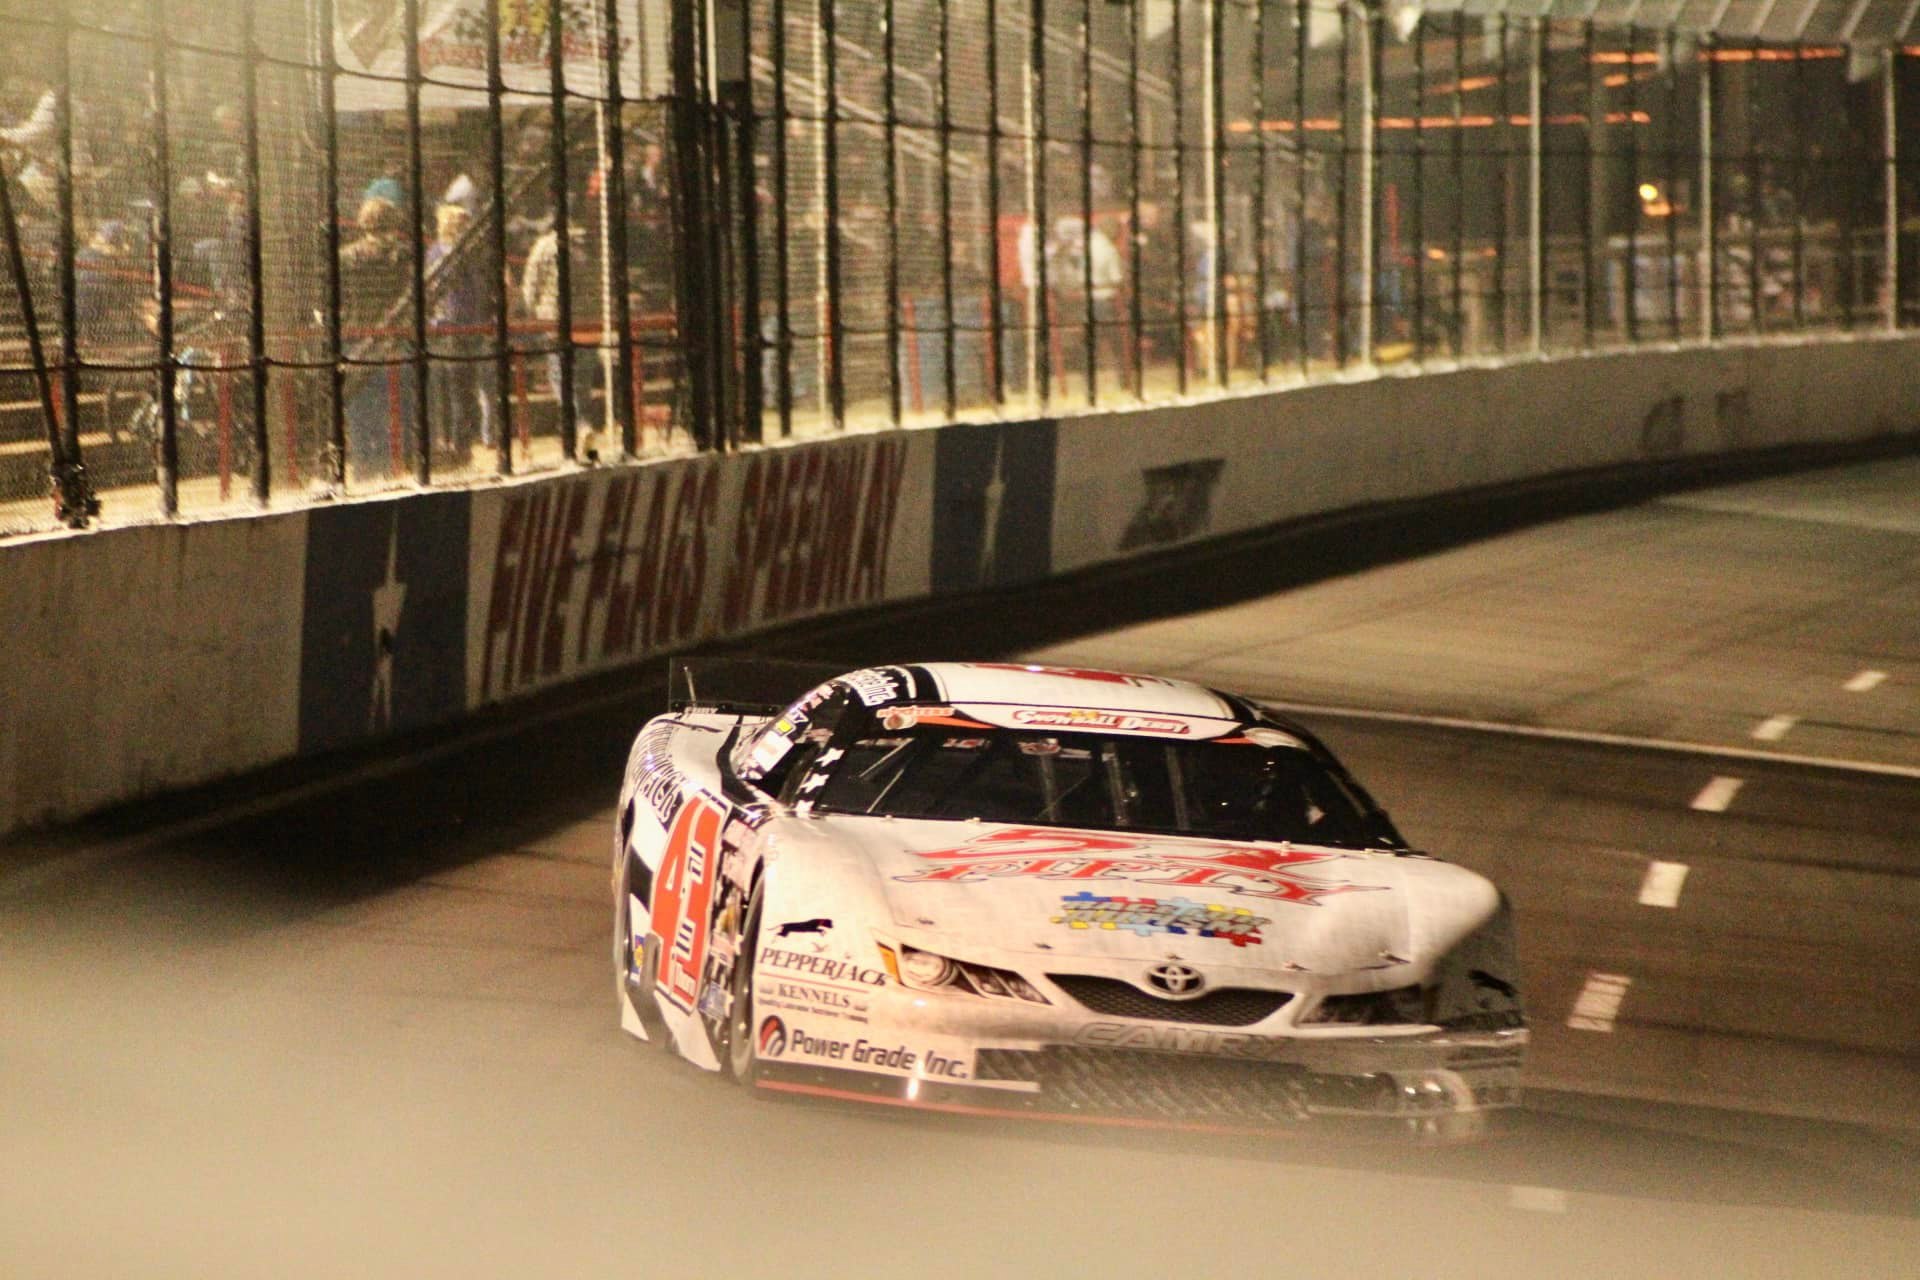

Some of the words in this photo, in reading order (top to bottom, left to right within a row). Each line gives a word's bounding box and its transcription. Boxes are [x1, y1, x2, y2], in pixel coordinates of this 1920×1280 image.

[759, 947, 887, 986] PEPPERJACK
[778, 983, 850, 1008] KENNELS
[790, 1029, 849, 1059] Power
[852, 1038, 916, 1070] Grade
[925, 1050, 968, 1079] Inc.
